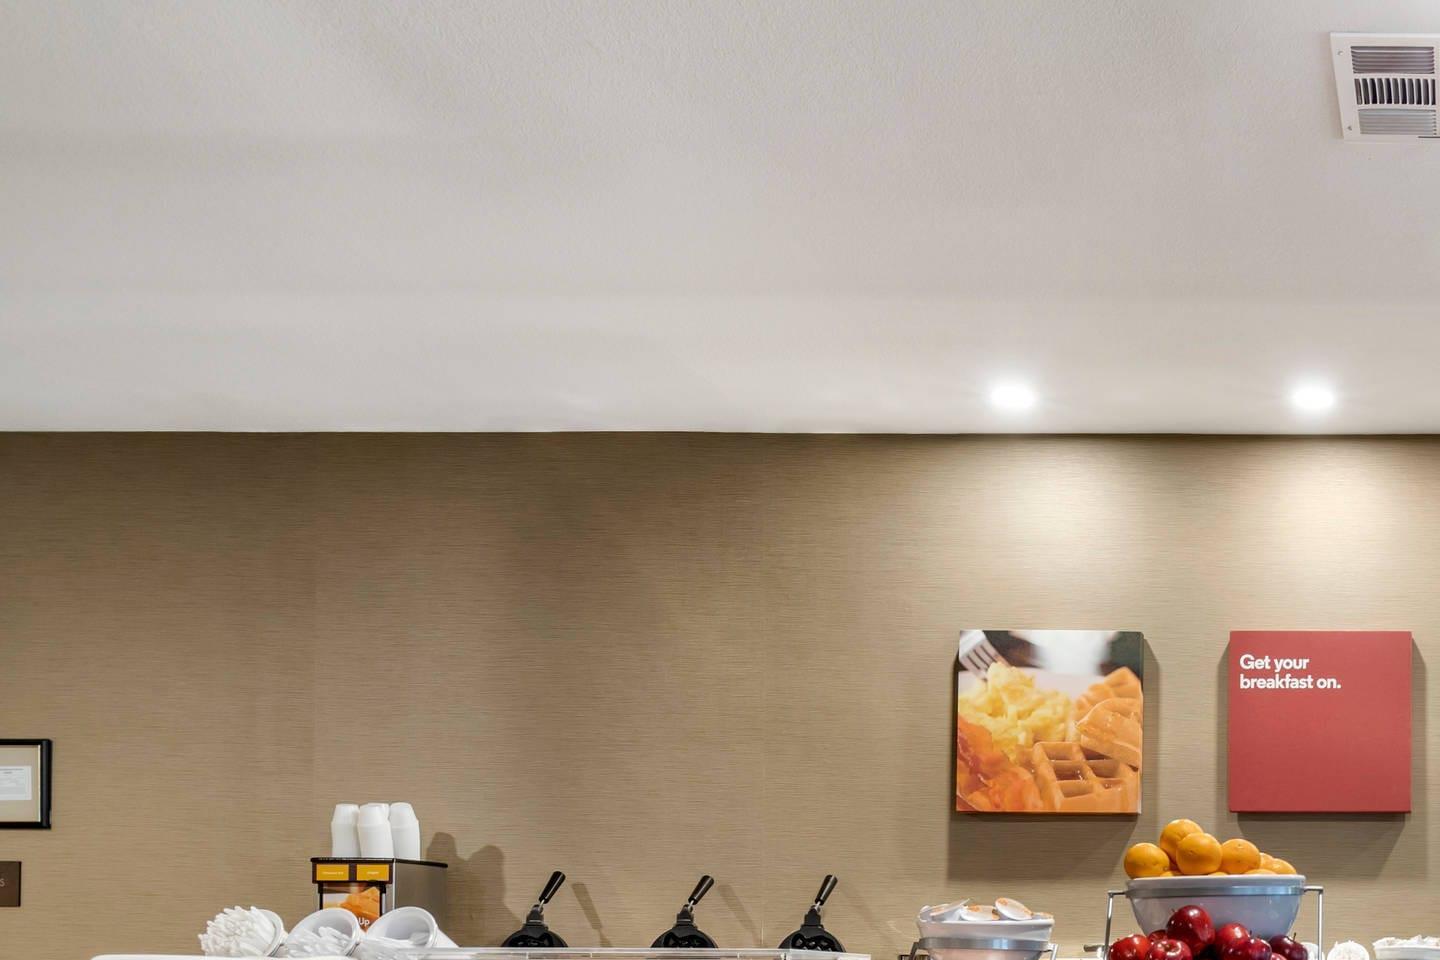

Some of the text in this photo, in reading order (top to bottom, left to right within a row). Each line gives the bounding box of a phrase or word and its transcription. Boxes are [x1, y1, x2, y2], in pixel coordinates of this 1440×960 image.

[1239, 654, 1310, 673] Get your
[1239, 673, 1342, 689] breakfast on.
